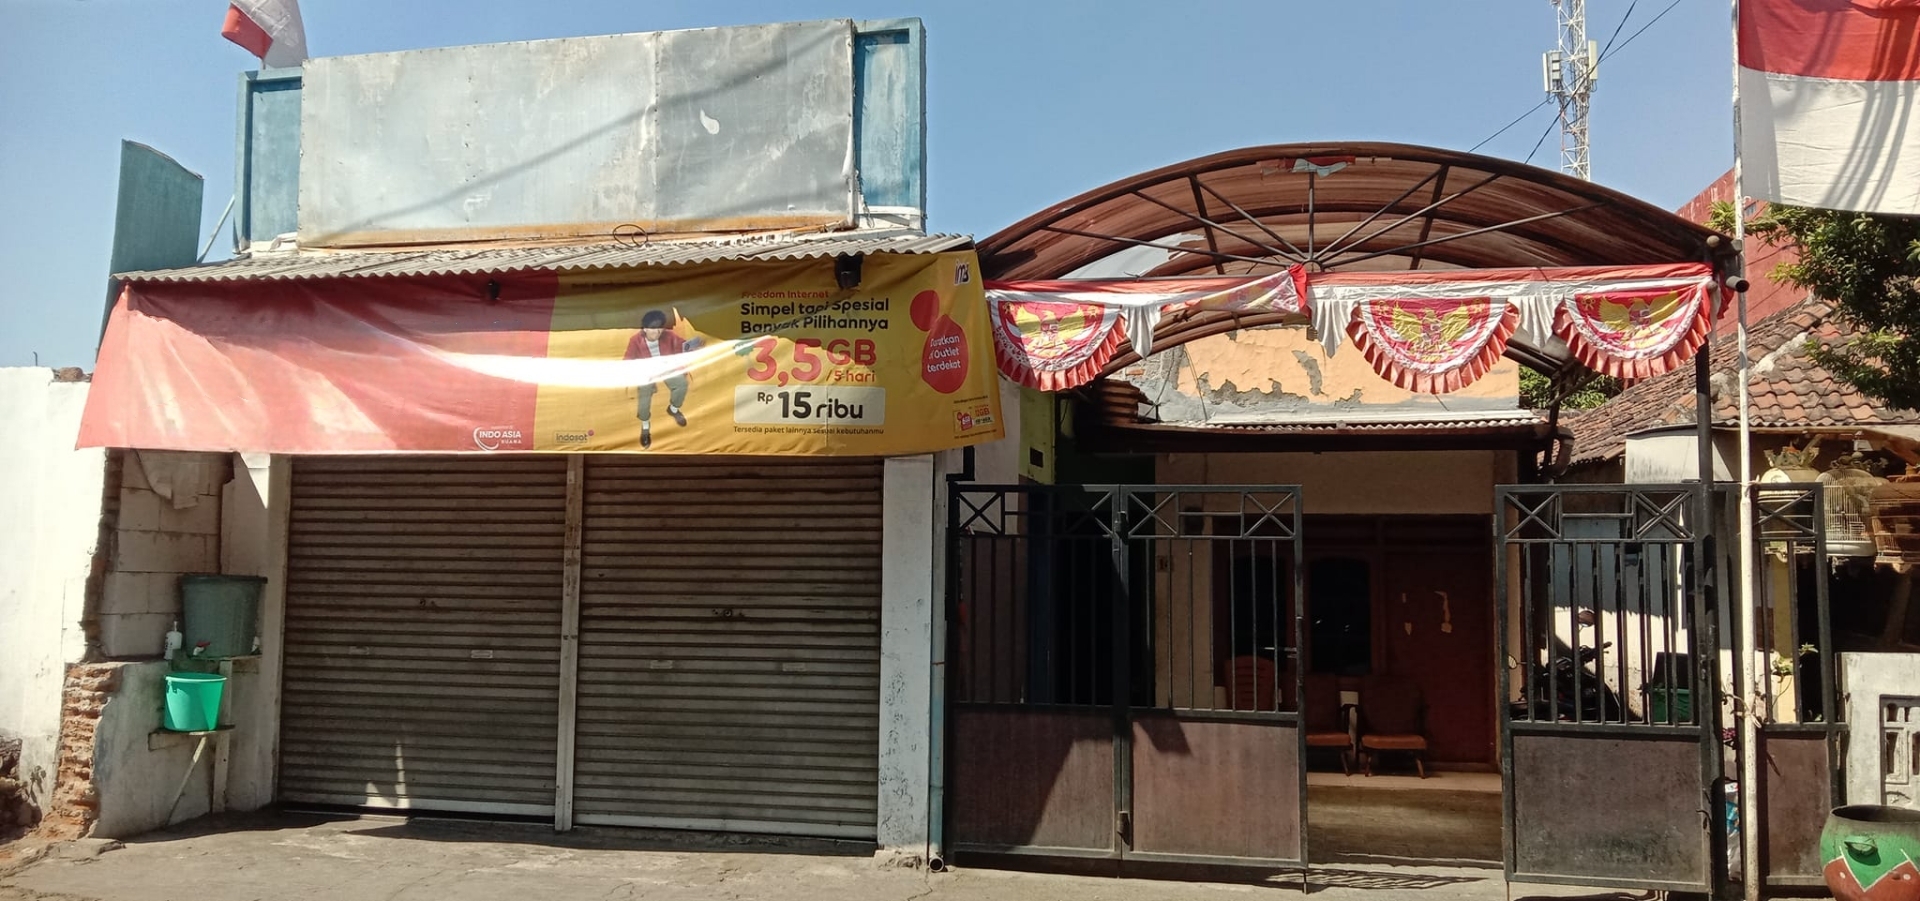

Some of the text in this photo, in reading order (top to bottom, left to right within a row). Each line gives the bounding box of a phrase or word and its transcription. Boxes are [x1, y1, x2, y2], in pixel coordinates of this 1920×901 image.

[742, 290, 829, 299] Freedom Internet
[741, 298, 889, 318] Simpel tapi Spesial
[741, 315, 888, 334] Banyak Pilihannya
[934, 347, 960, 359] Outlet
[747, 338, 877, 387] 3,5 GB
[927, 359, 961, 373] terdekat
[846, 370, 875, 382] hari
[757, 391, 863, 418] Rp 15 ribu
[764, 427, 785, 435] paket
[786, 427, 812, 436] lainnya
